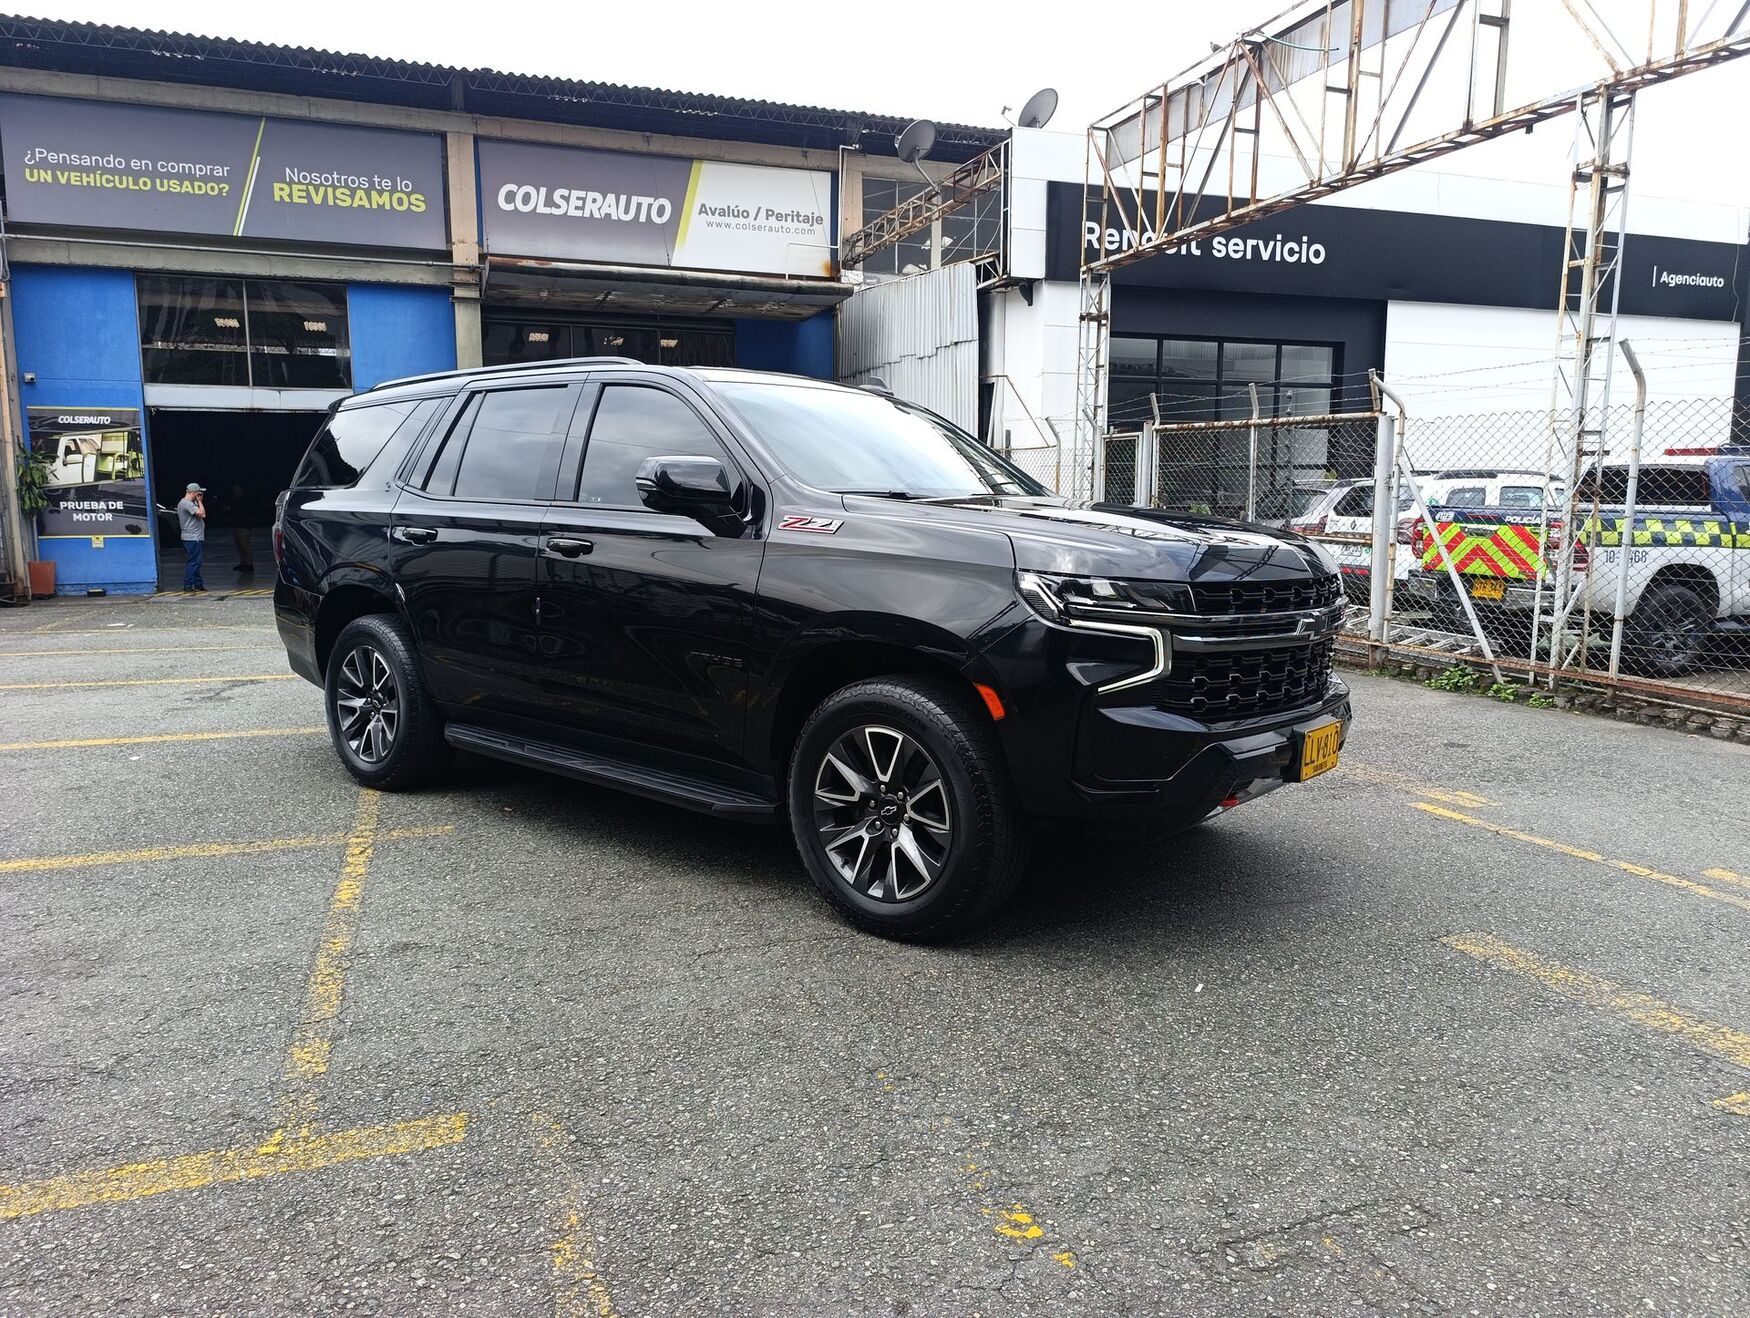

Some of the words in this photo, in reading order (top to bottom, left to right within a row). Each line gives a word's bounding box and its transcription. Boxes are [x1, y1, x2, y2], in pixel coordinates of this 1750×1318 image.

[24, 148, 126, 169] ¿Pensando
[130, 158, 153, 172] en
[157, 161, 231, 178] comprar
[25, 168, 53, 183] UN
[56, 170, 152, 191] VEHÍCULO
[156, 178, 230, 196] USADO?
[285, 167, 369, 188] Nosotros
[373, 175, 392, 190] te
[397, 177, 412, 192] lo
[272, 182, 427, 213] REVISAMOS
[497, 183, 672, 225] COLSERAUTO
[698, 203, 750, 219] Avalúo
[765, 208, 824, 227] Peritaje
[705, 220, 816, 236] www.colserauto.com
[1212, 234, 1326, 265] servicio
[1660, 271, 1724, 288] Agenciauto
[58, 415, 111, 425] COLSERAUTO
[60, 501, 107, 510] PRUEBA
[108, 501, 124, 510] DE
[73, 512, 113, 521] MOTOR
